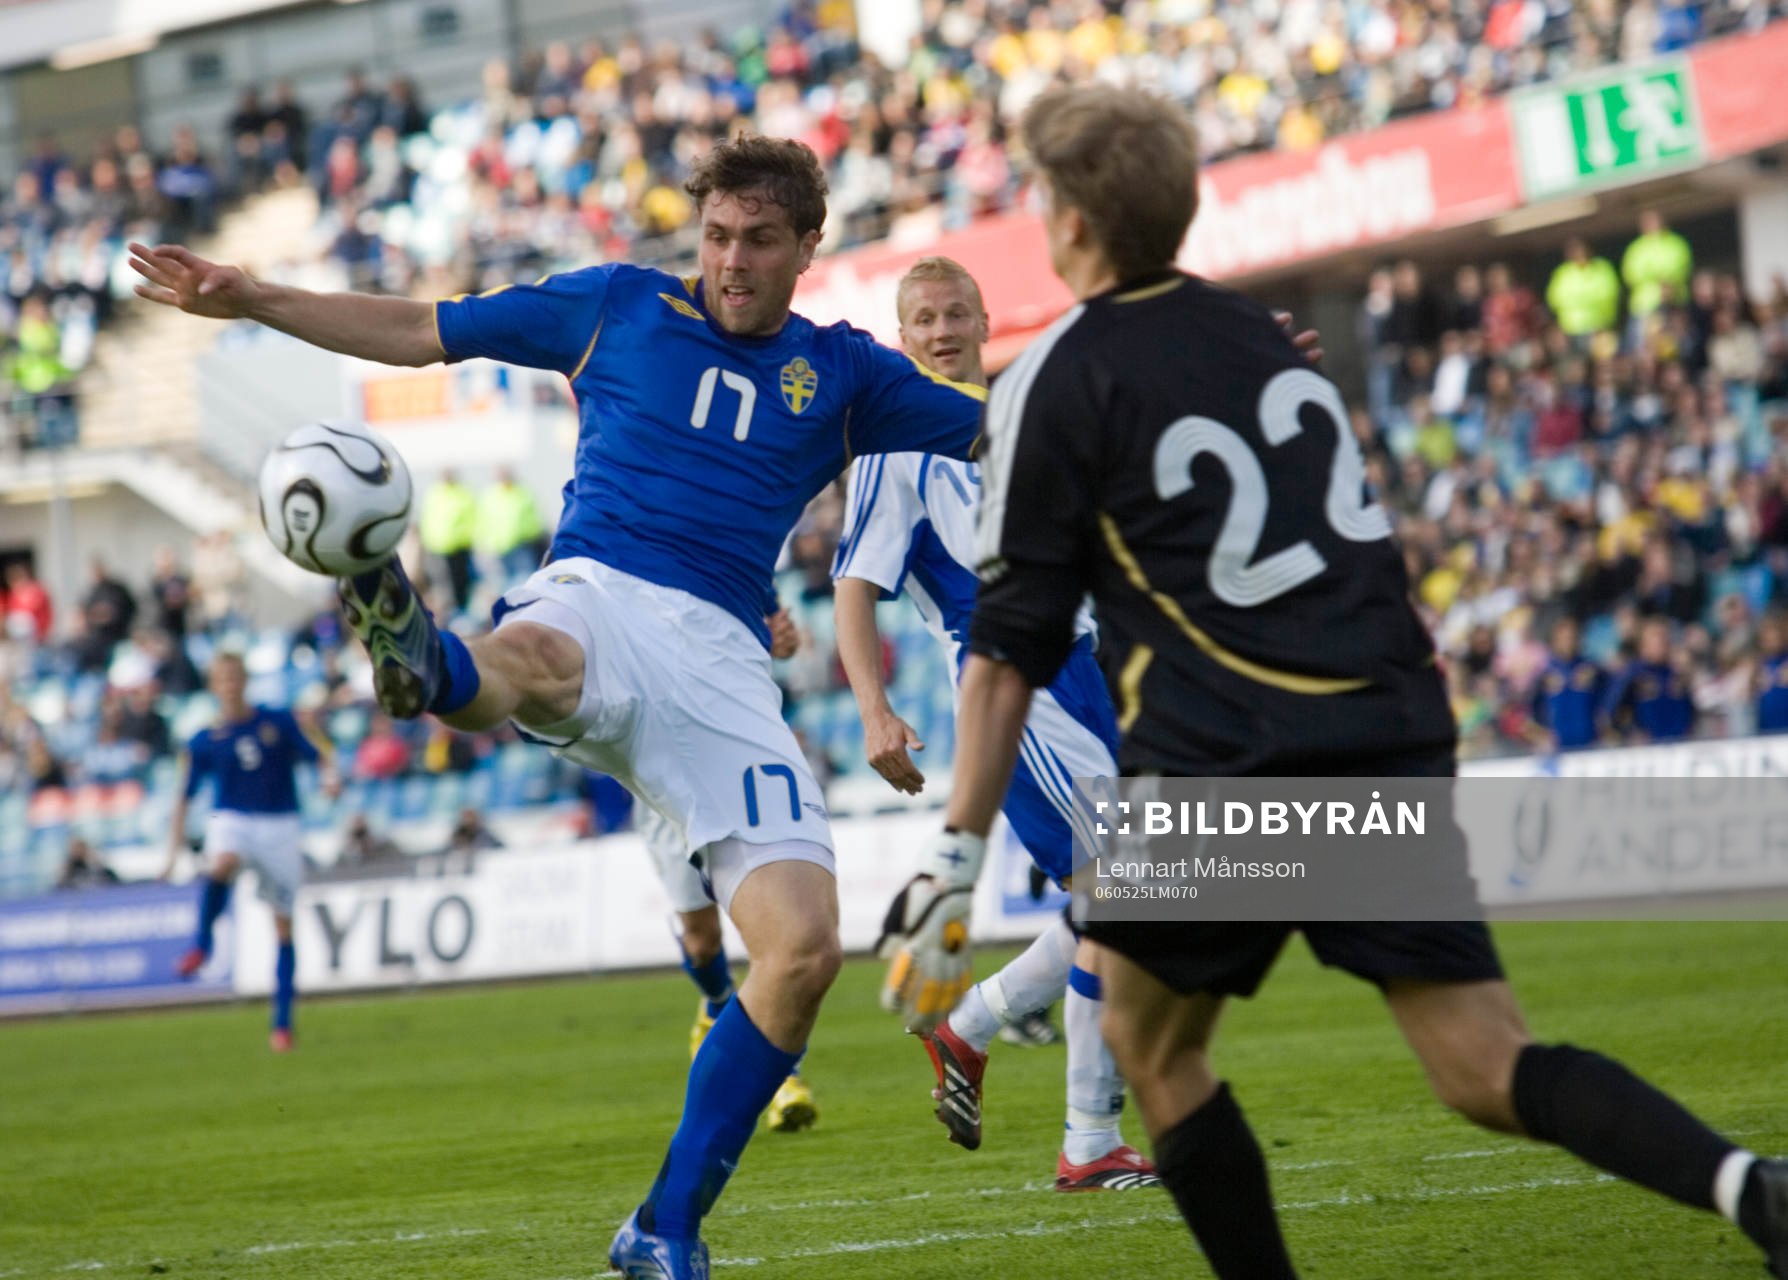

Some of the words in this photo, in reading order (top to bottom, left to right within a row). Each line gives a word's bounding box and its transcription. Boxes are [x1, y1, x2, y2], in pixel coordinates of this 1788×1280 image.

[690, 367, 757, 442] 17
[1154, 368, 1393, 607] 22
[743, 764, 802, 827] 17
